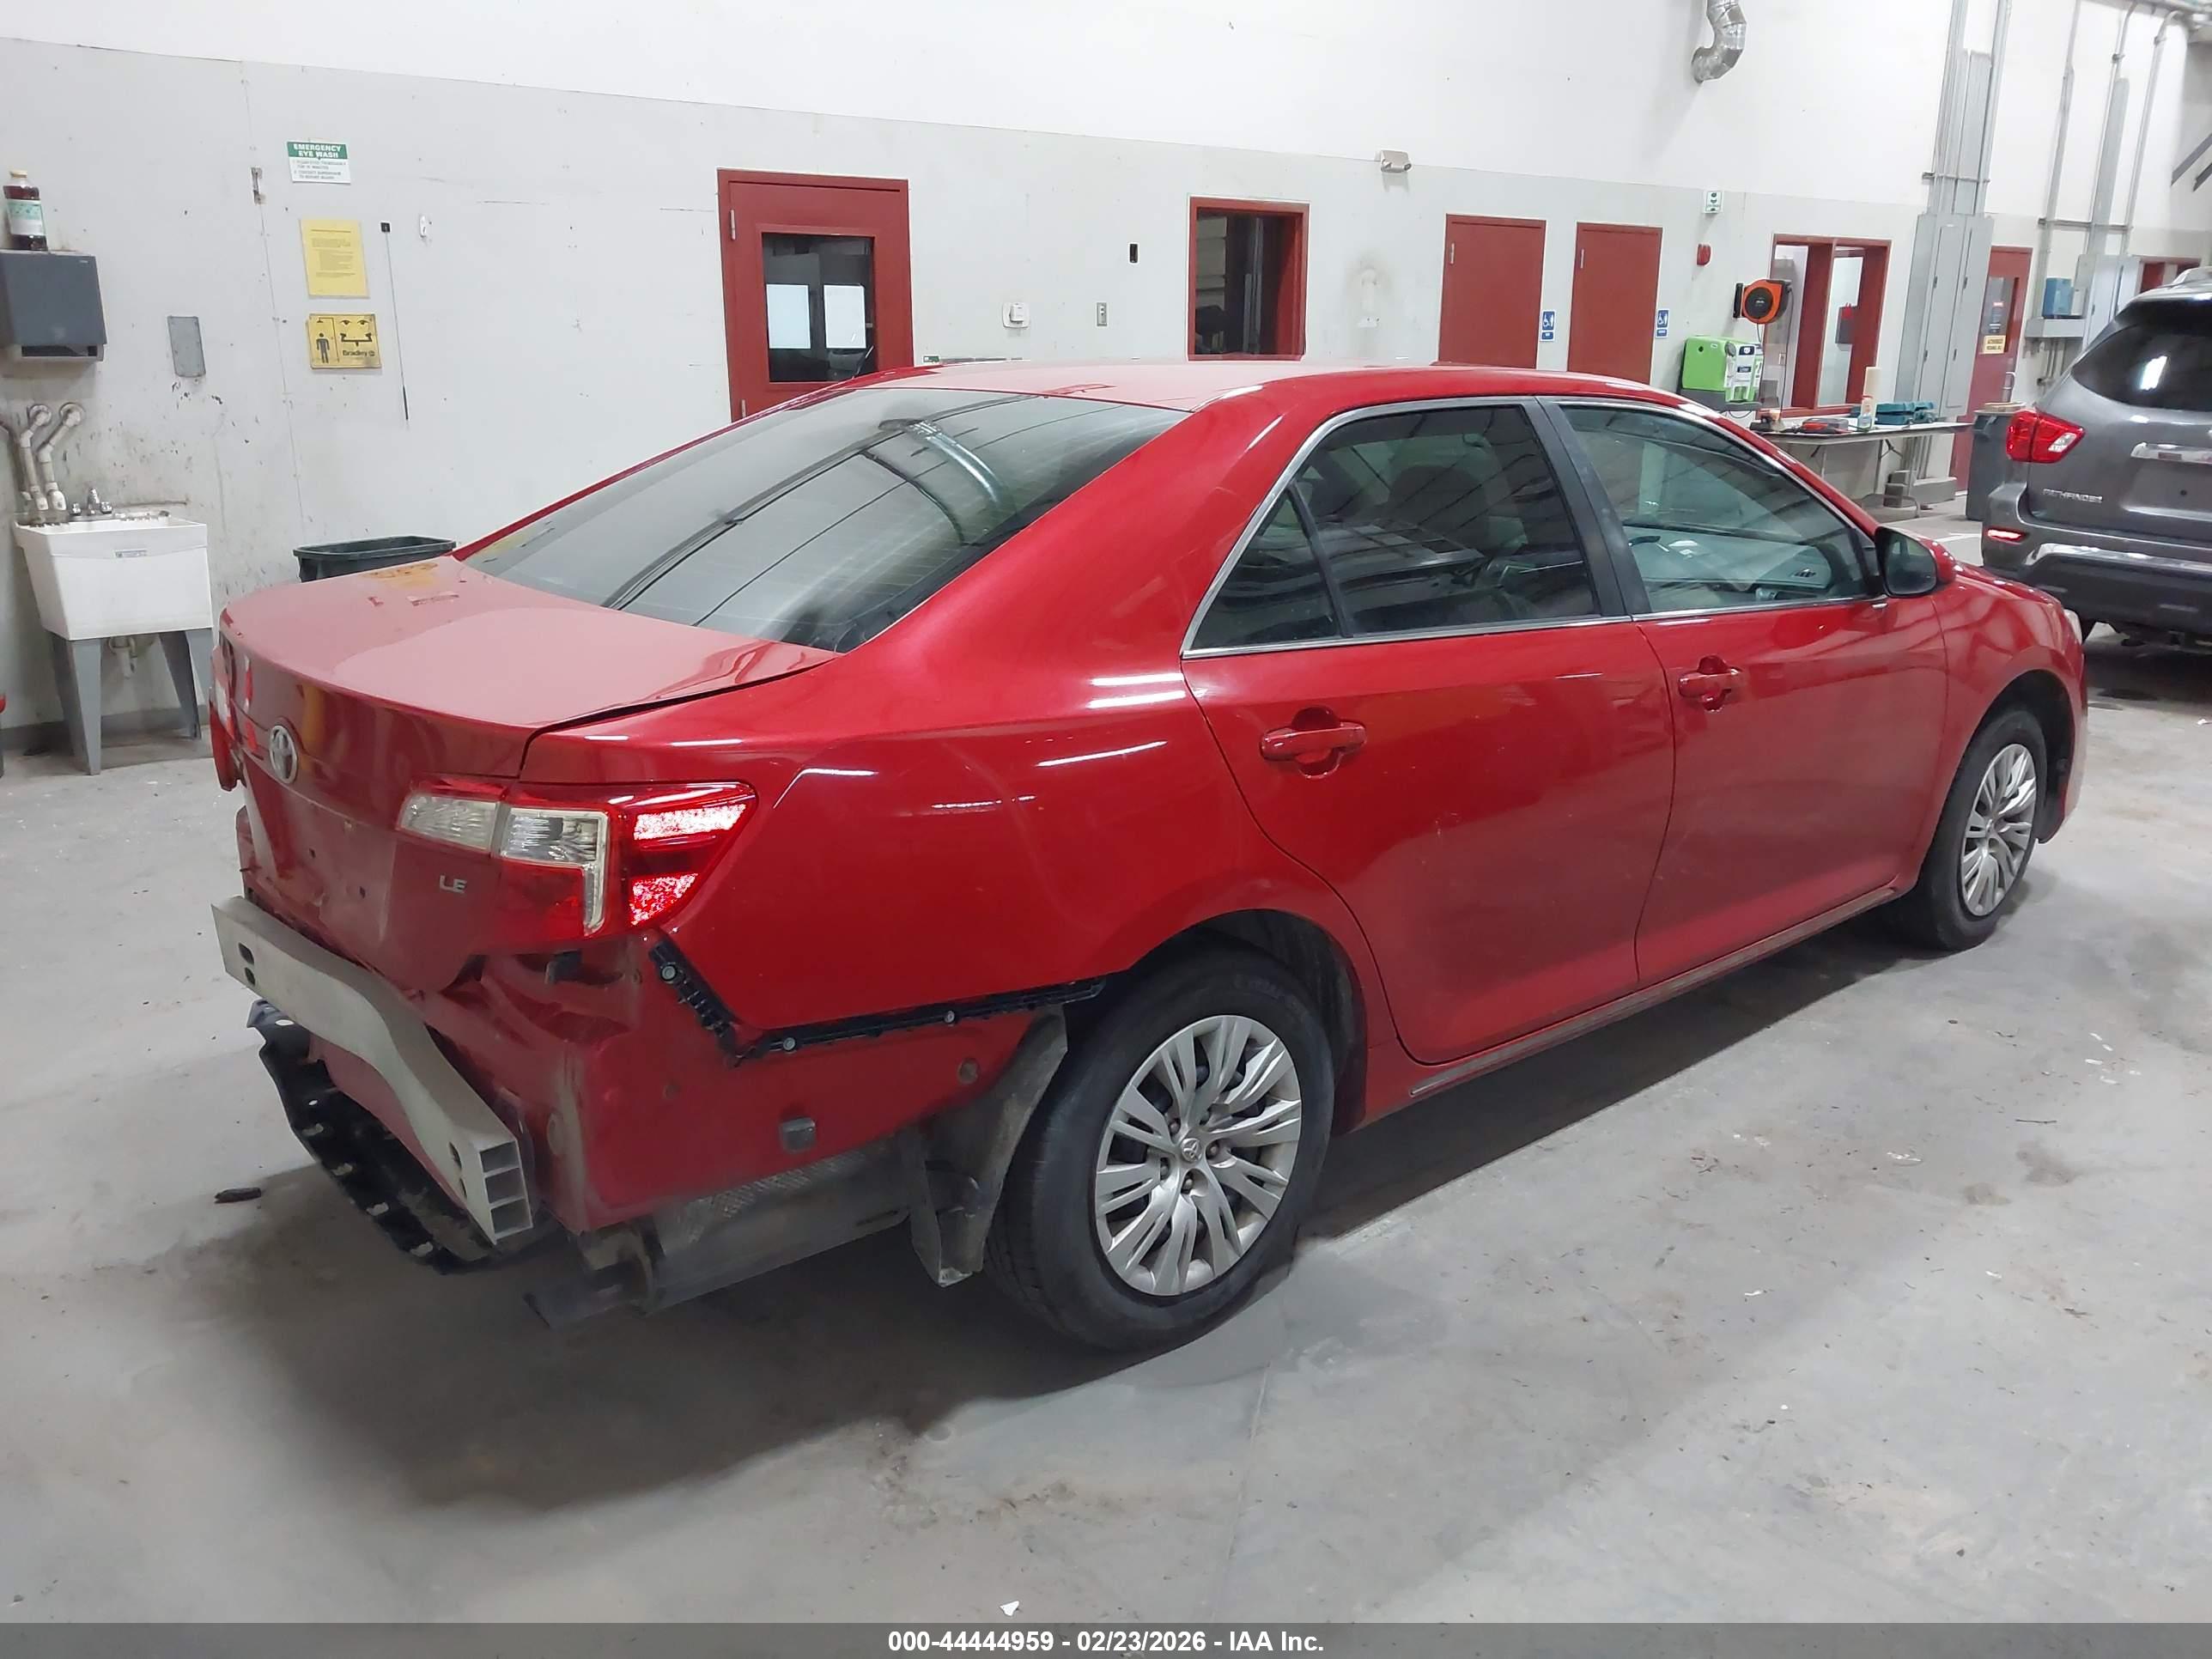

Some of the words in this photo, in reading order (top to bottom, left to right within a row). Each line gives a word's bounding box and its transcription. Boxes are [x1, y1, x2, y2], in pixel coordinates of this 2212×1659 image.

[293, 143, 342, 152] EMERGENCY
[2043, 488, 2103, 503] PATHFINDER
[439, 875, 468, 894] LE
